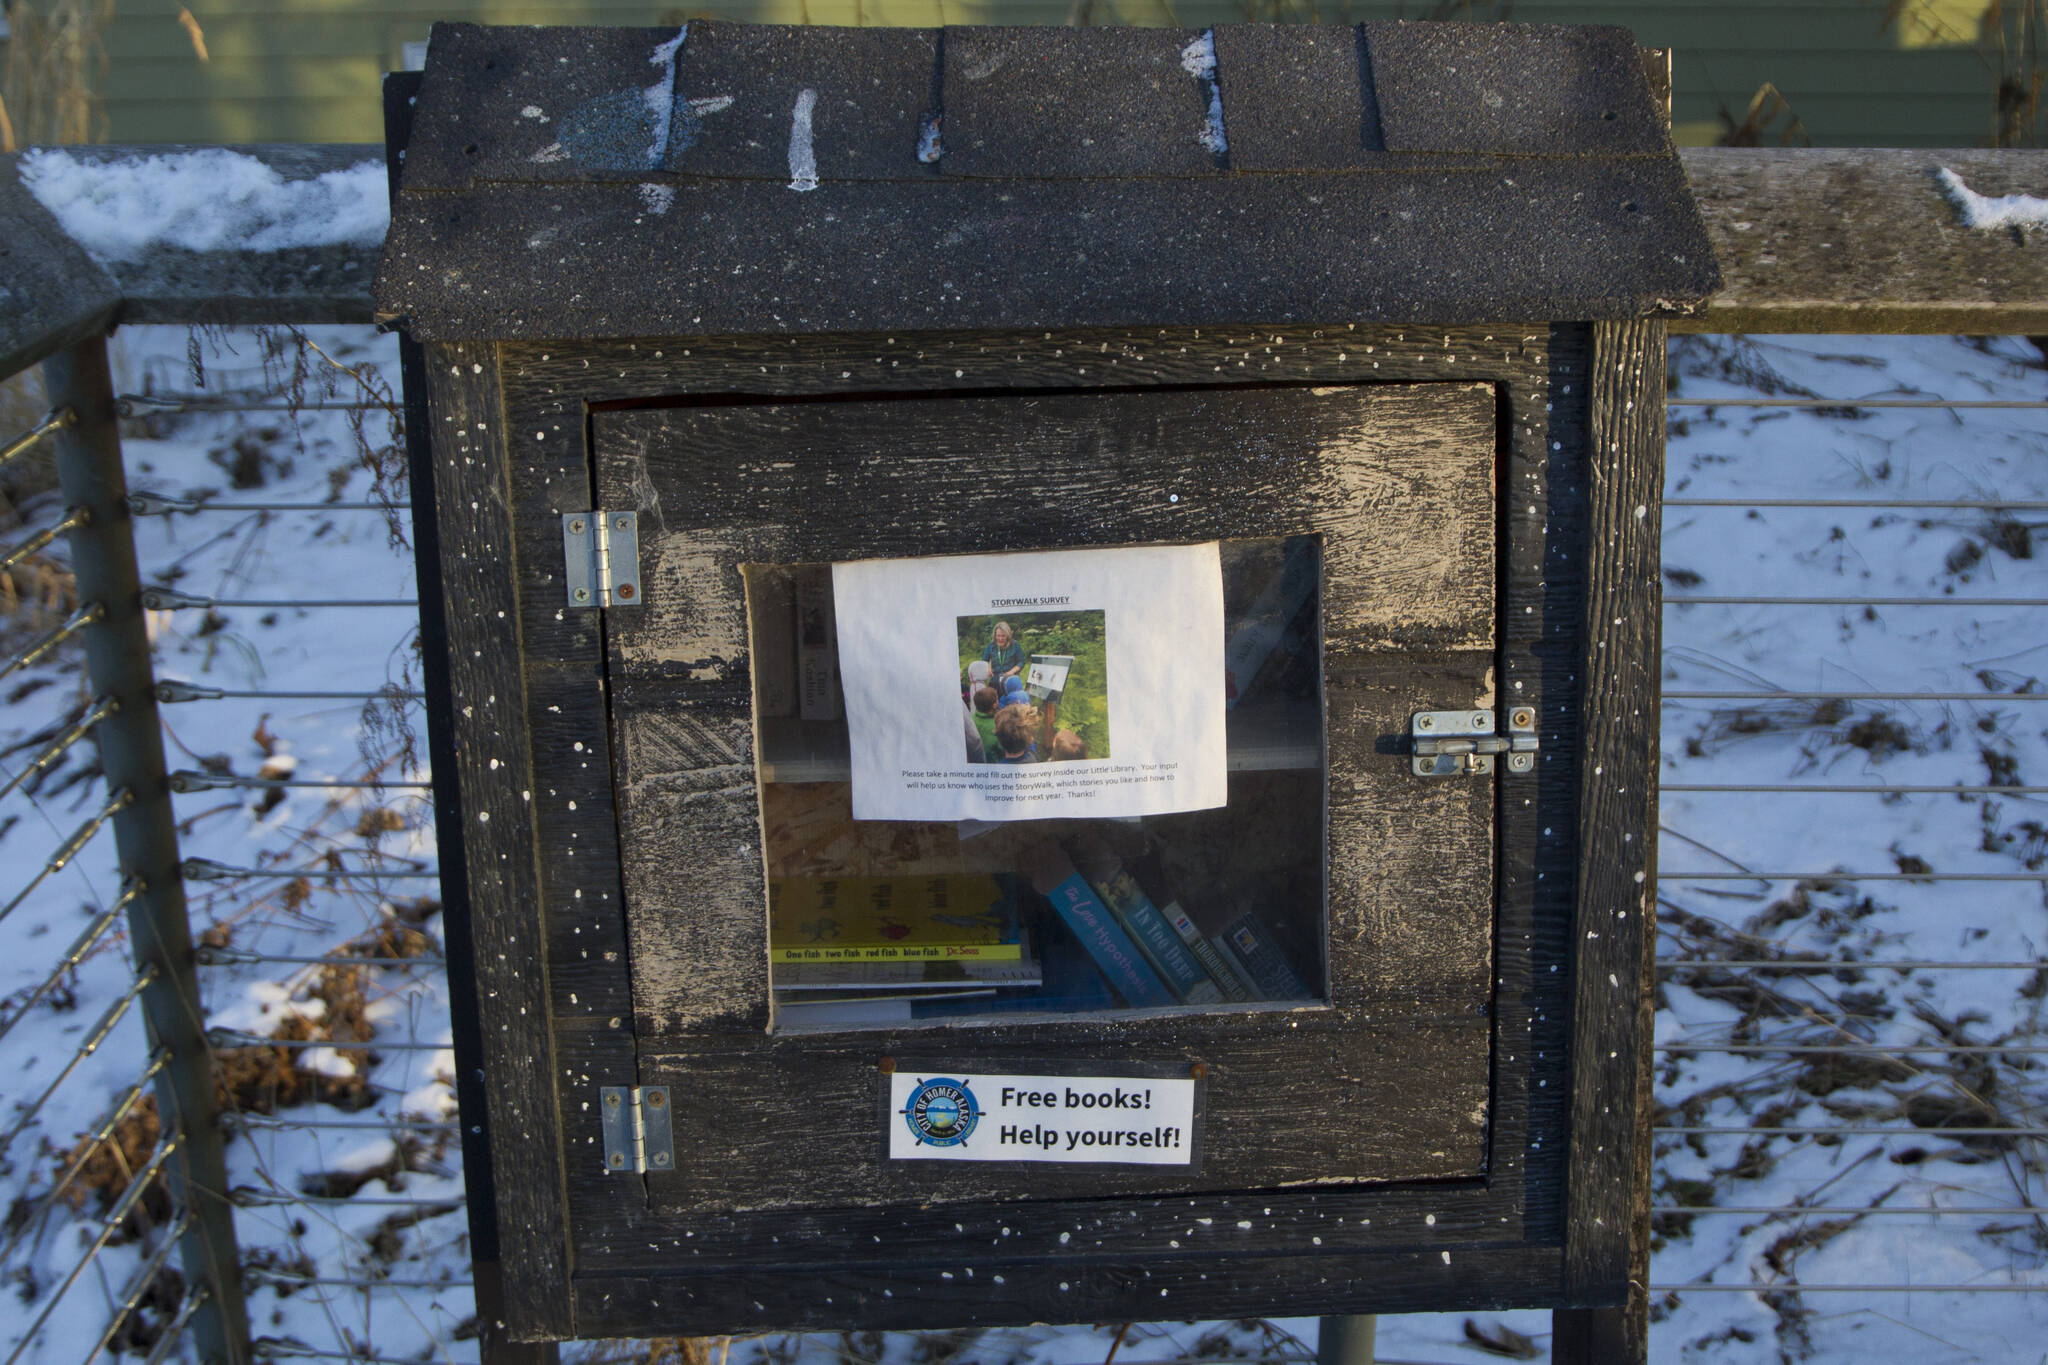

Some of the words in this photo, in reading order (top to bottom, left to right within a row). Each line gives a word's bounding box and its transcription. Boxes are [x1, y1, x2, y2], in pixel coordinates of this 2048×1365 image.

[991, 598, 1038, 607] STORYWALK
[1040, 596, 1070, 605] SURVEY
[902, 770, 924, 778] Please
[926, 770, 942, 778] take
[950, 770, 974, 778] minute
[976, 770, 988, 778] and
[990, 770, 999, 778] fill
[1001, 771, 1013, 779] out
[1015, 771, 1027, 779] the
[1111, 765, 1138, 774] Library.
[1159, 762, 1178, 771] input
[920, 782, 936, 790] help
[968, 782, 983, 790] who
[1015, 780, 1054, 791] StoryWalk,
[1079, 778, 1103, 786] stories
[1150, 774, 1165, 782] how
[1045, 793, 1064, 801] year.
[1068, 790, 1096, 798] Thanks!
[786, 950, 802, 958] One
[804, 950, 820, 958] fish
[825, 950, 842, 958] two
[844, 949, 860, 957] fish
[866, 949, 879, 957] red
[882, 948, 898, 956] fish
[904, 948, 920, 956] blue
[923, 948, 939, 956] fish
[925, 1087, 958, 1100] HOMER
[1001, 1087, 1057, 1107] Free
[1065, 1088, 1151, 1109] books!
[917, 1098, 928, 1109] OF
[916, 1113, 932, 1131] CITY
[952, 1098, 969, 1131] ALASKA
[1000, 1125, 1058, 1150] Help
[1066, 1127, 1181, 1150] yourself!
